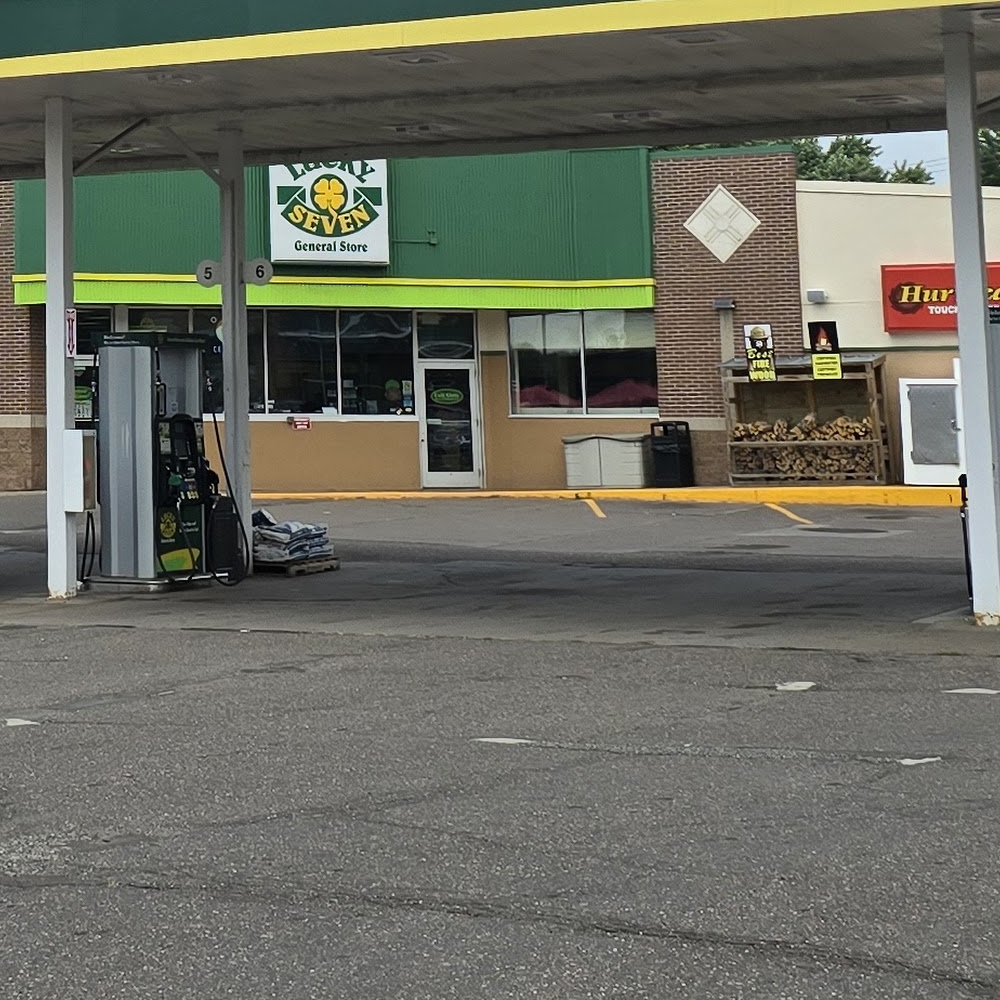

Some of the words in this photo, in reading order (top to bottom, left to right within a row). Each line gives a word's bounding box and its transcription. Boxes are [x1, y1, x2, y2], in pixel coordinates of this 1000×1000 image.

[288, 204, 371, 235] SEVEN
[294, 240, 337, 252] General
[339, 240, 368, 252] Store
[203, 267, 213, 280] 5
[255, 264, 265, 278] 6
